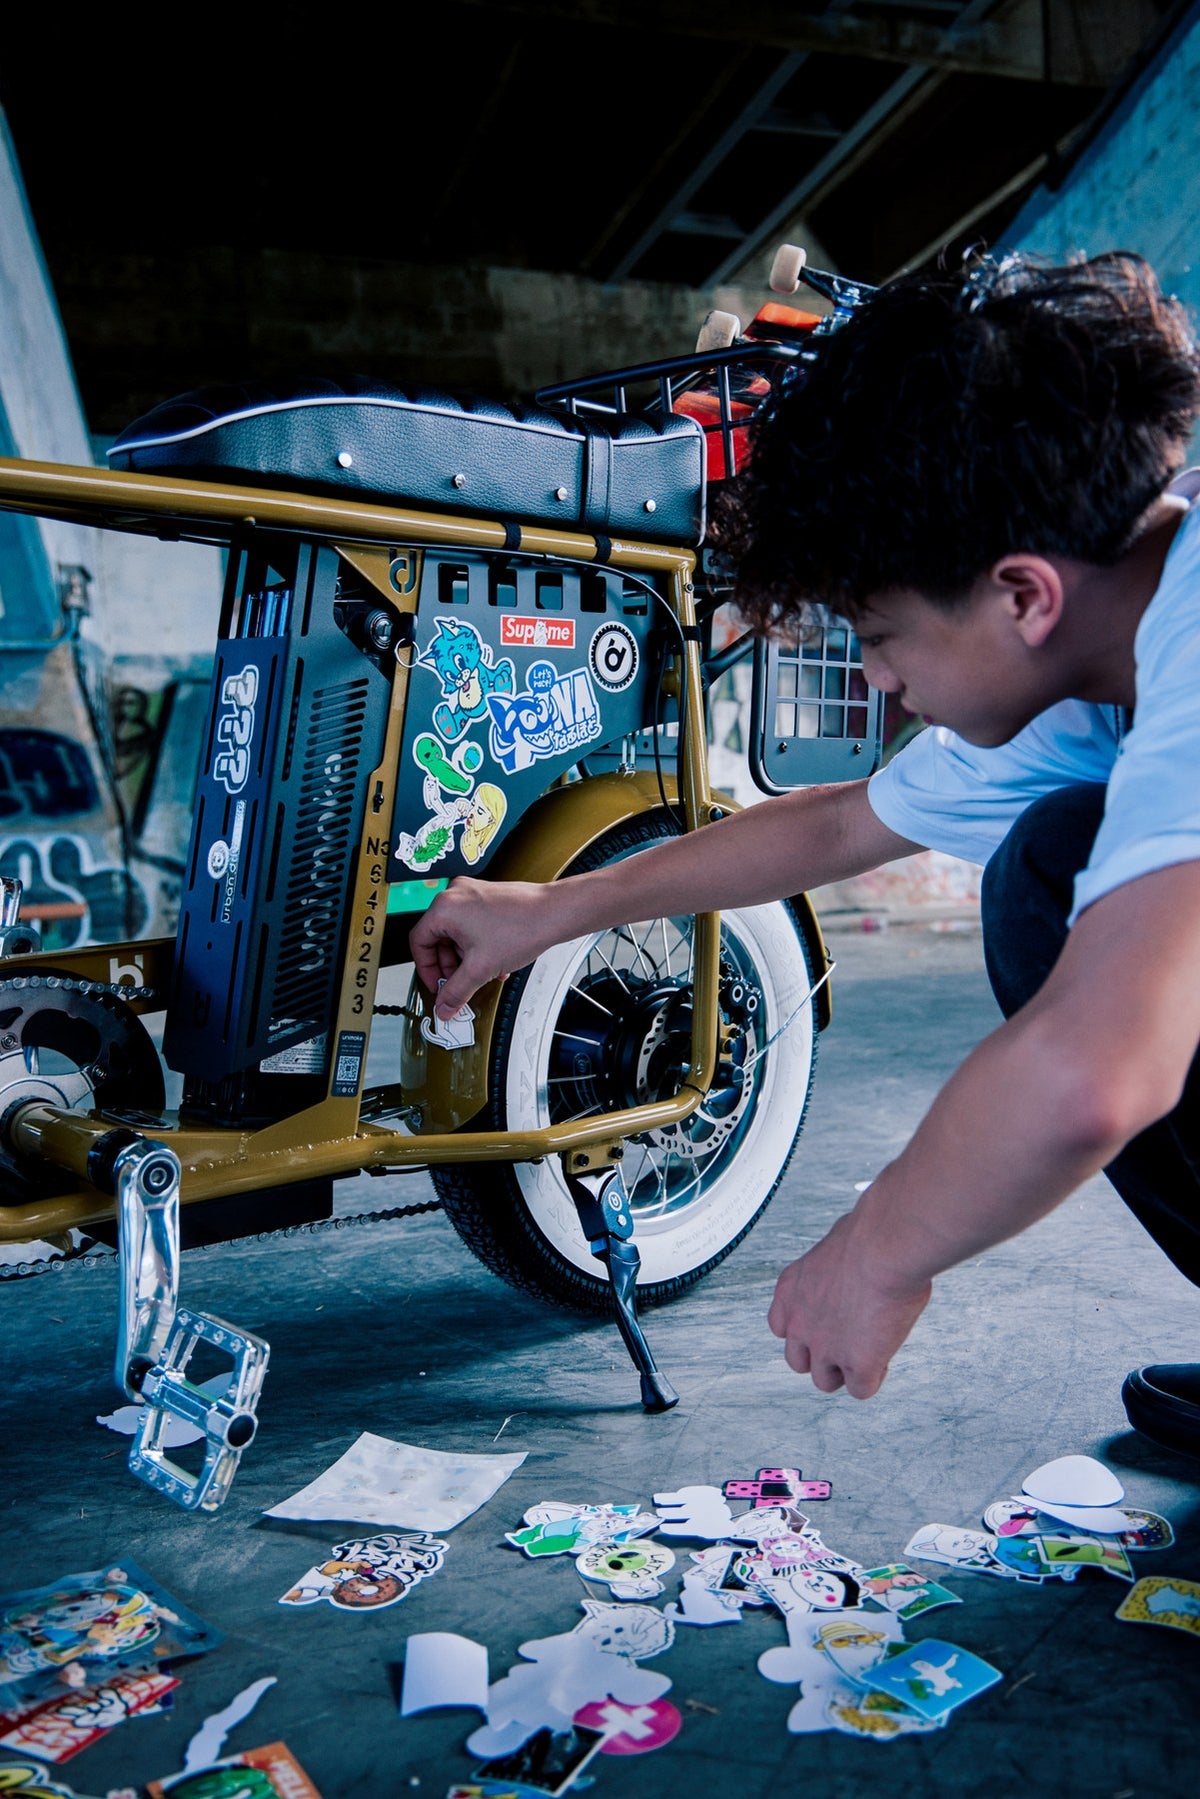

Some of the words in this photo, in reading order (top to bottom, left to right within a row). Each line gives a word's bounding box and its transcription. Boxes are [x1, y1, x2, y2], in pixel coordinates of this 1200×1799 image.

[505, 617, 571, 645] Supme
[532, 669, 553, 680] Let's
[532, 679, 553, 689] race!
[584, 1542, 619, 1568] NERDS
[628, 1552, 665, 1579] LATER
